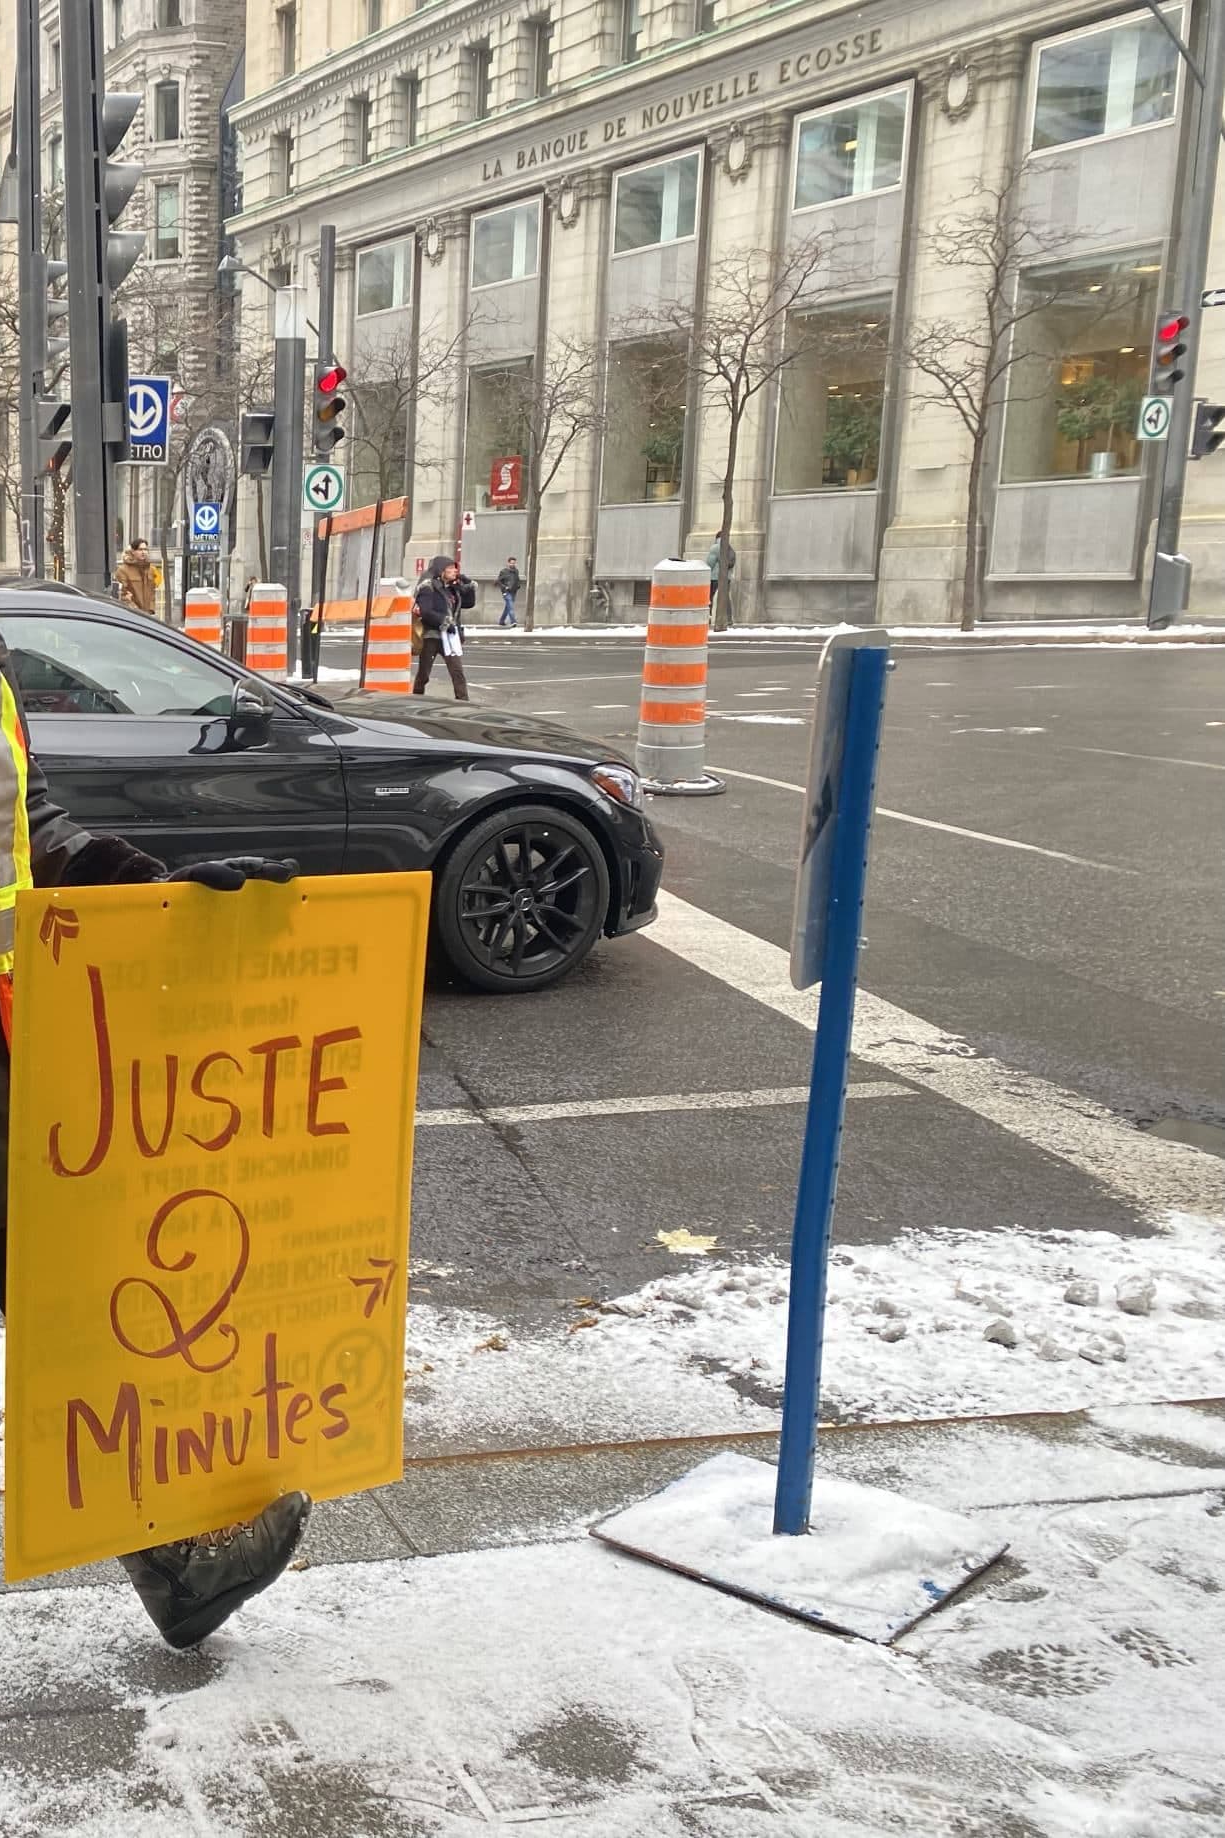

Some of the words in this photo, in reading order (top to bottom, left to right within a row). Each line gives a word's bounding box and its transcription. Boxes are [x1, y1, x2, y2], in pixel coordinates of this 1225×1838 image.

[482, 157, 504, 182] LA
[515, 129, 590, 168] BANQUE
[603, 116, 628, 143] DE
[641, 70, 761, 130] NOUVELLE
[777, 27, 883, 84] ECOSSE
[109, 1188, 250, 1374] 2
